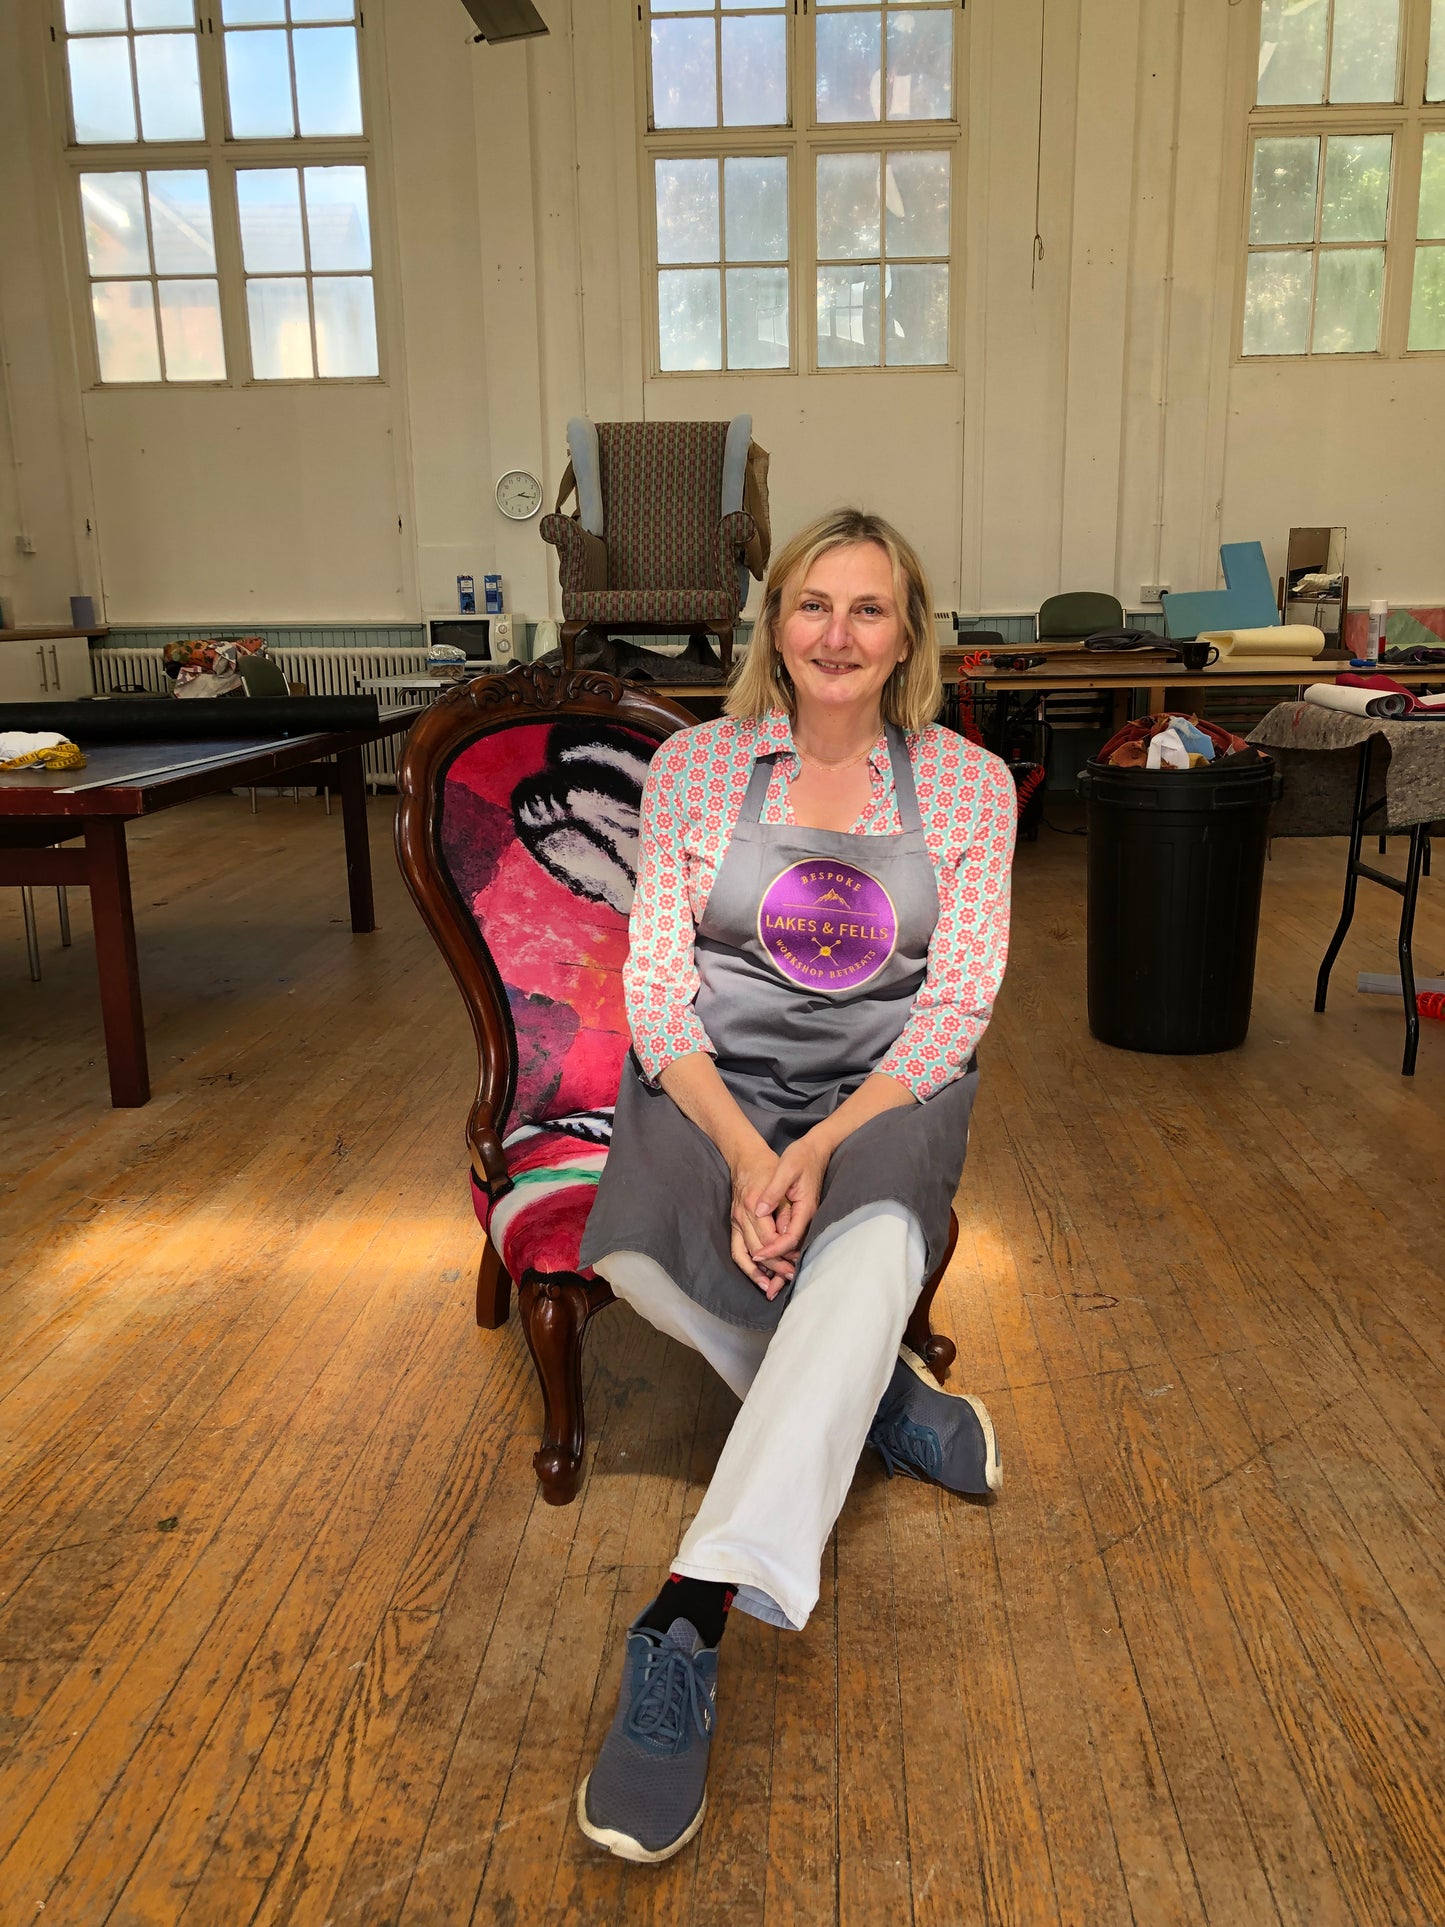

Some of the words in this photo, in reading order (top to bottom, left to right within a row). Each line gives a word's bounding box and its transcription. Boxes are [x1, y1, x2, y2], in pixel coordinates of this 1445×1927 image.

[801, 871, 862, 892] BESPOKE
[766, 914, 817, 932] LAKES
[822, 921, 834, 935] &
[839, 923, 889, 940] FELLS
[775, 938, 825, 978] WORKSHOP
[829, 949, 877, 979] RETREATS
